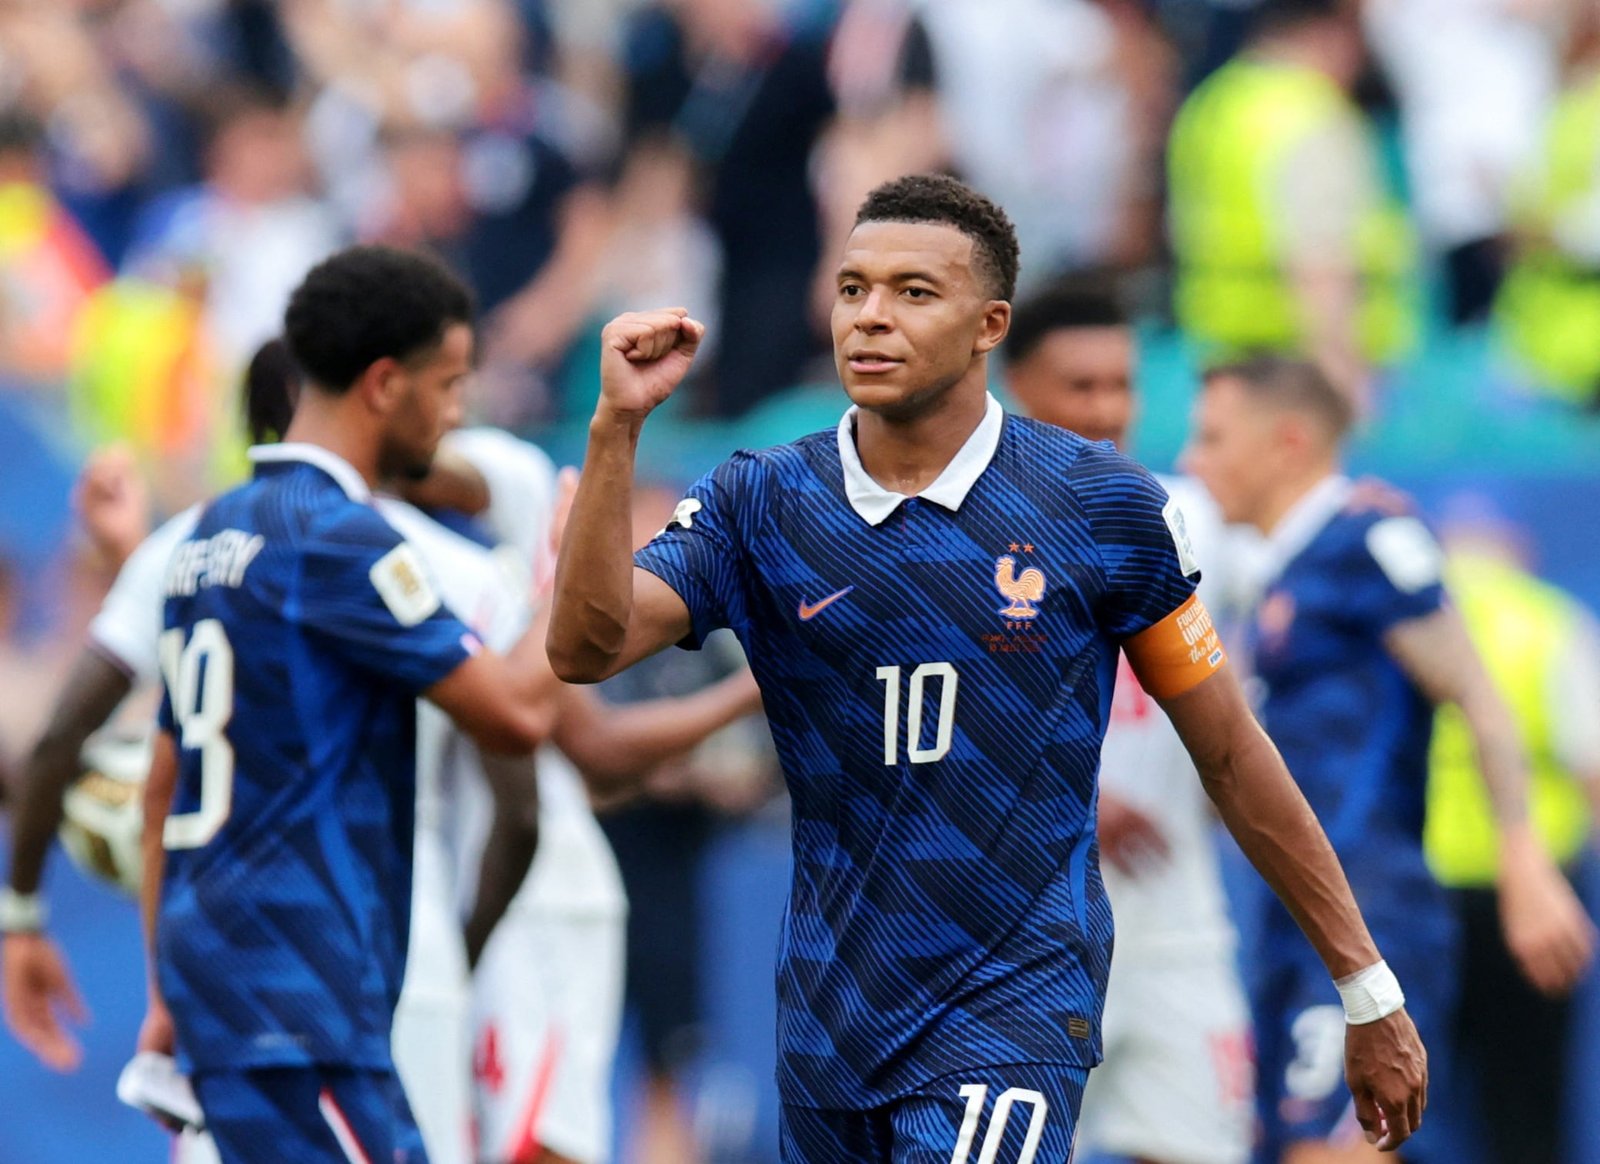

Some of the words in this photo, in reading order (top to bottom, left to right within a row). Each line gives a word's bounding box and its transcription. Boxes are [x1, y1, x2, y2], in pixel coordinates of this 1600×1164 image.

[1006, 621, 1033, 631] FFF
[876, 661, 959, 766] 10
[950, 1083, 1048, 1164] 10
